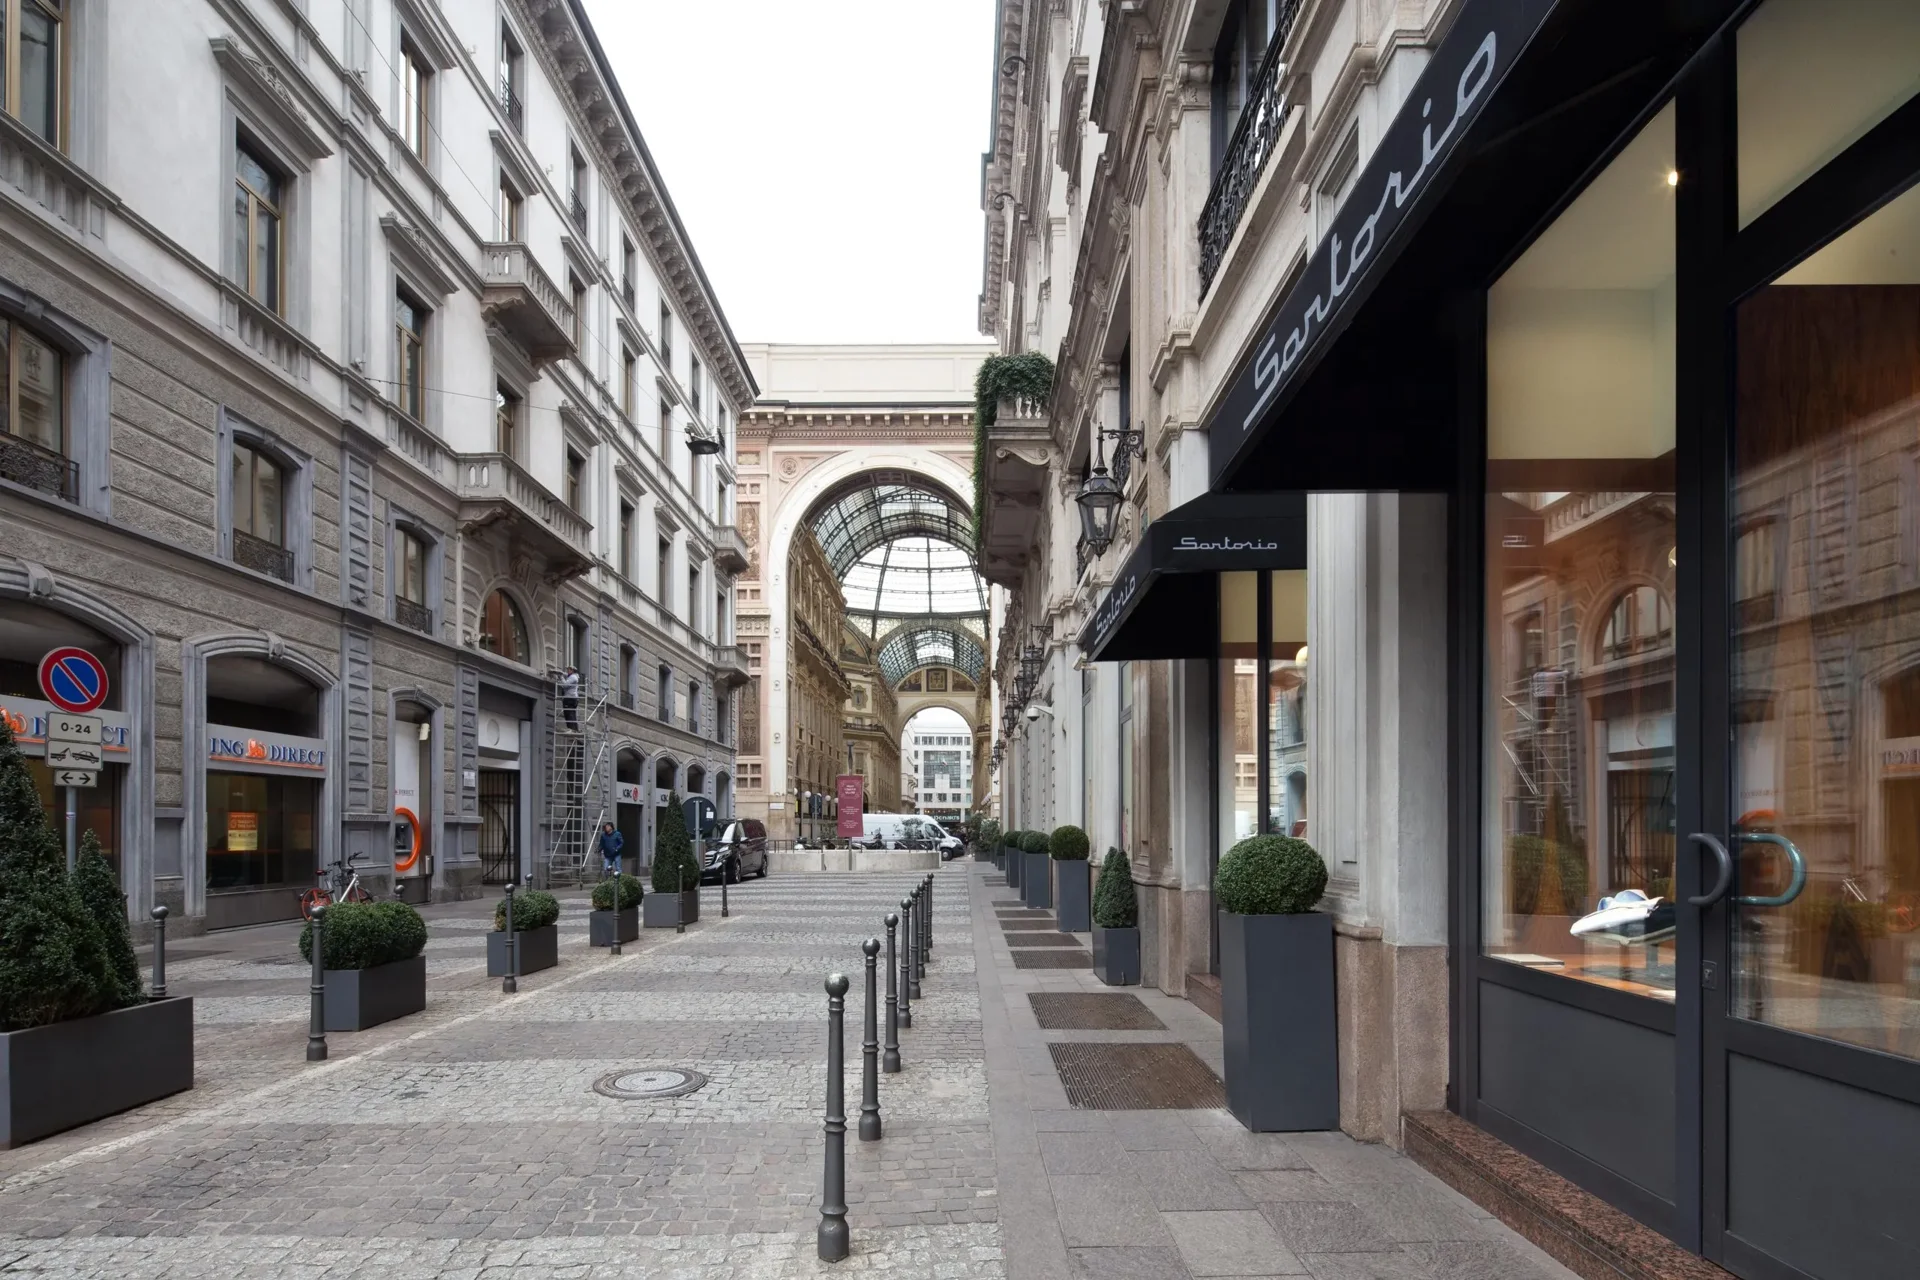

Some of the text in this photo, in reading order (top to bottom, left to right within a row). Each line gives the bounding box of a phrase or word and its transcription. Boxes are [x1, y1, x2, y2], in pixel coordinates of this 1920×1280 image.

[1243, 30, 1497, 430] Sartorio
[1172, 536, 1278, 551] Sartorio
[1094, 574, 1136, 646] Sartorio
[60, 722, 92, 735] 0-24
[210, 737, 326, 766] ING DIRECT
